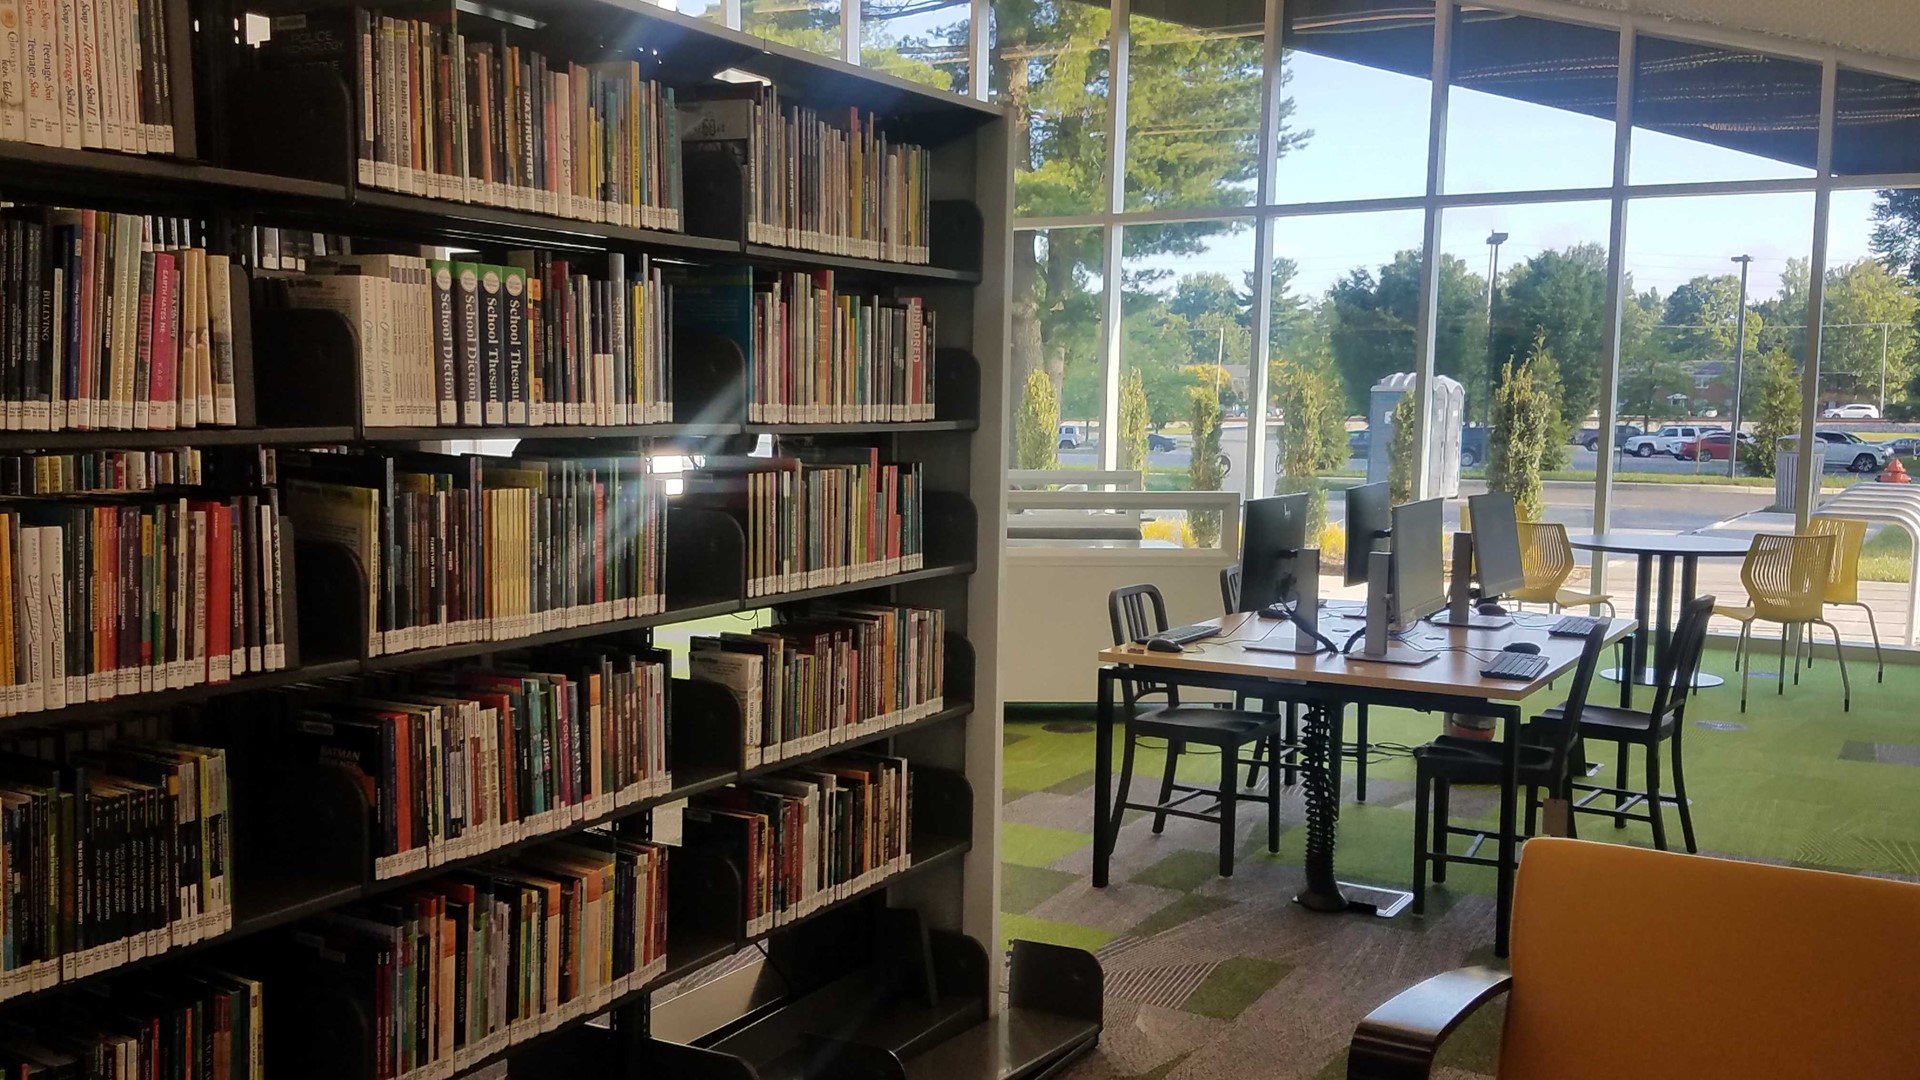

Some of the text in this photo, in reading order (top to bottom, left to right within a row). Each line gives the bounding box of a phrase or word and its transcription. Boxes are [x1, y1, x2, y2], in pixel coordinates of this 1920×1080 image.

[62, 1, 71, 23] Soup
[81, 1, 91, 23] Soup
[27, 38, 37, 78] Teenage
[42, 42, 52, 81] Teenage
[64, 43, 74, 85] Teenage
[83, 42, 93, 85] Teenage
[30, 79, 39, 98] Soul
[44, 82, 54, 101] Soul
[66, 86, 75, 106] Soul
[86, 85, 95, 104] Soul
[400, 80, 408, 117] Bullets,
[42, 290, 50, 341] BULLYING
[160, 323, 166, 334] ME
[487, 298, 497, 344] School
[509, 300, 521, 345] School
[616, 297, 624, 352] SCIENCE
[913, 305, 921, 362] UNBORED
[441, 293, 453, 399] School Diction
[465, 295, 478, 402] School Diction
